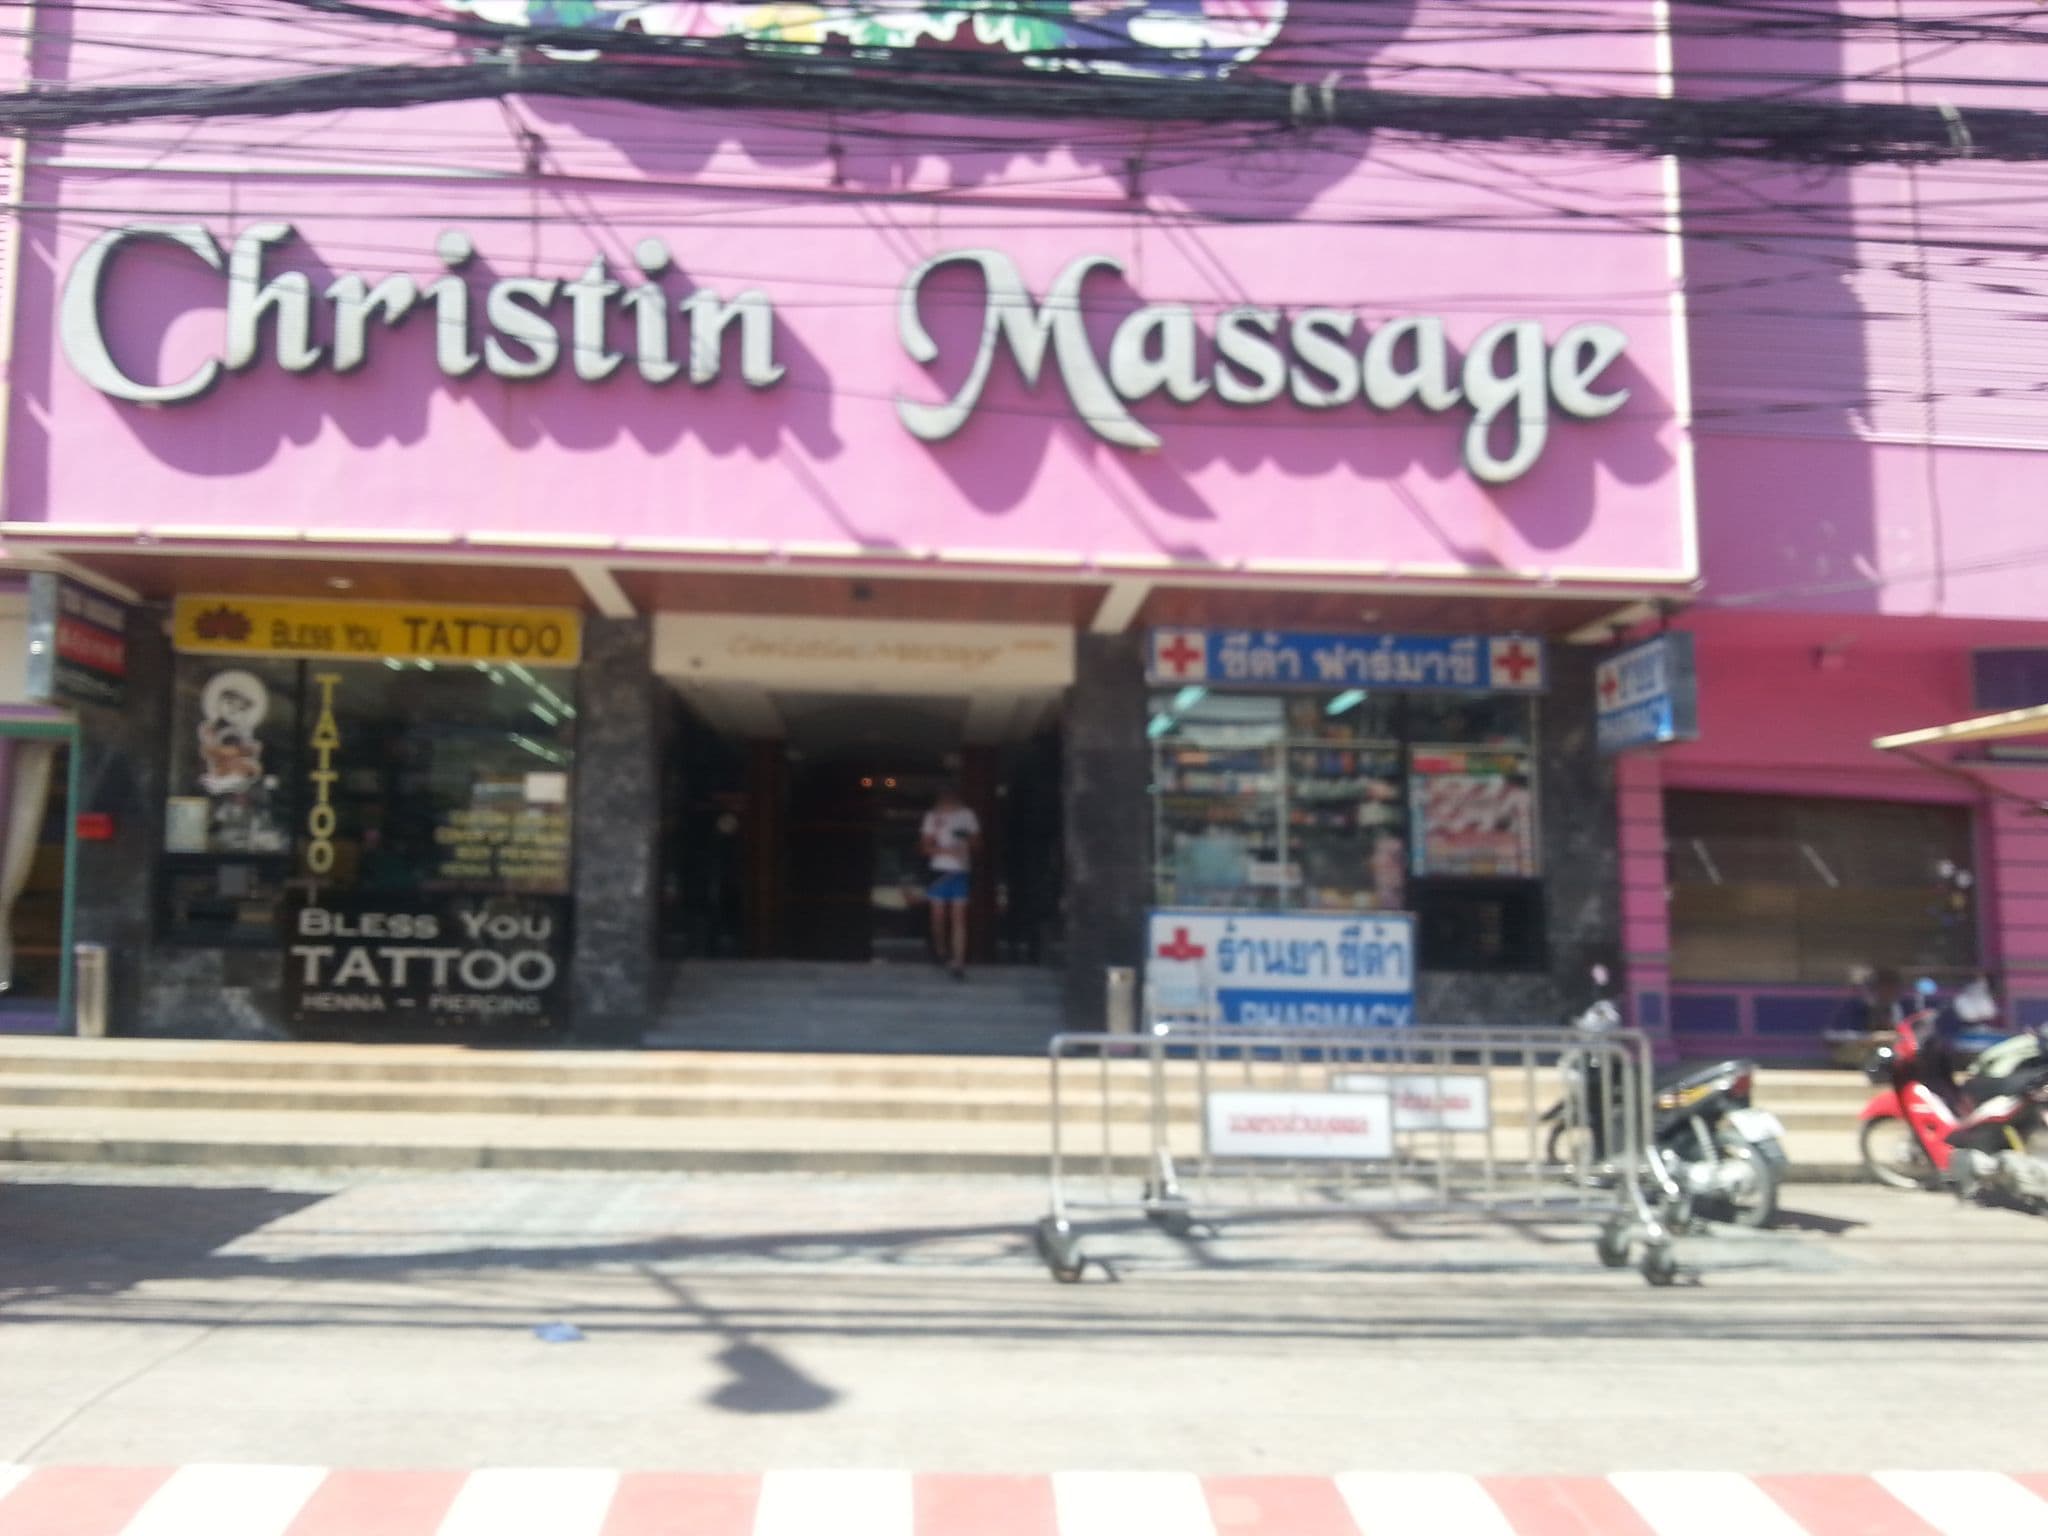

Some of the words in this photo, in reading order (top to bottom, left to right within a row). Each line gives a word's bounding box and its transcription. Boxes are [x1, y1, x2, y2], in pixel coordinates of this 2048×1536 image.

[60, 221, 786, 404] Christin
[896, 248, 1631, 485] Massage
[403, 616, 562, 657] TATTOO
[306, 672, 343, 874] TATTOO
[298, 907, 440, 940] BLESS
[290, 945, 557, 991] TATTOO
[1239, 1002, 1413, 1028] PHARMACY
